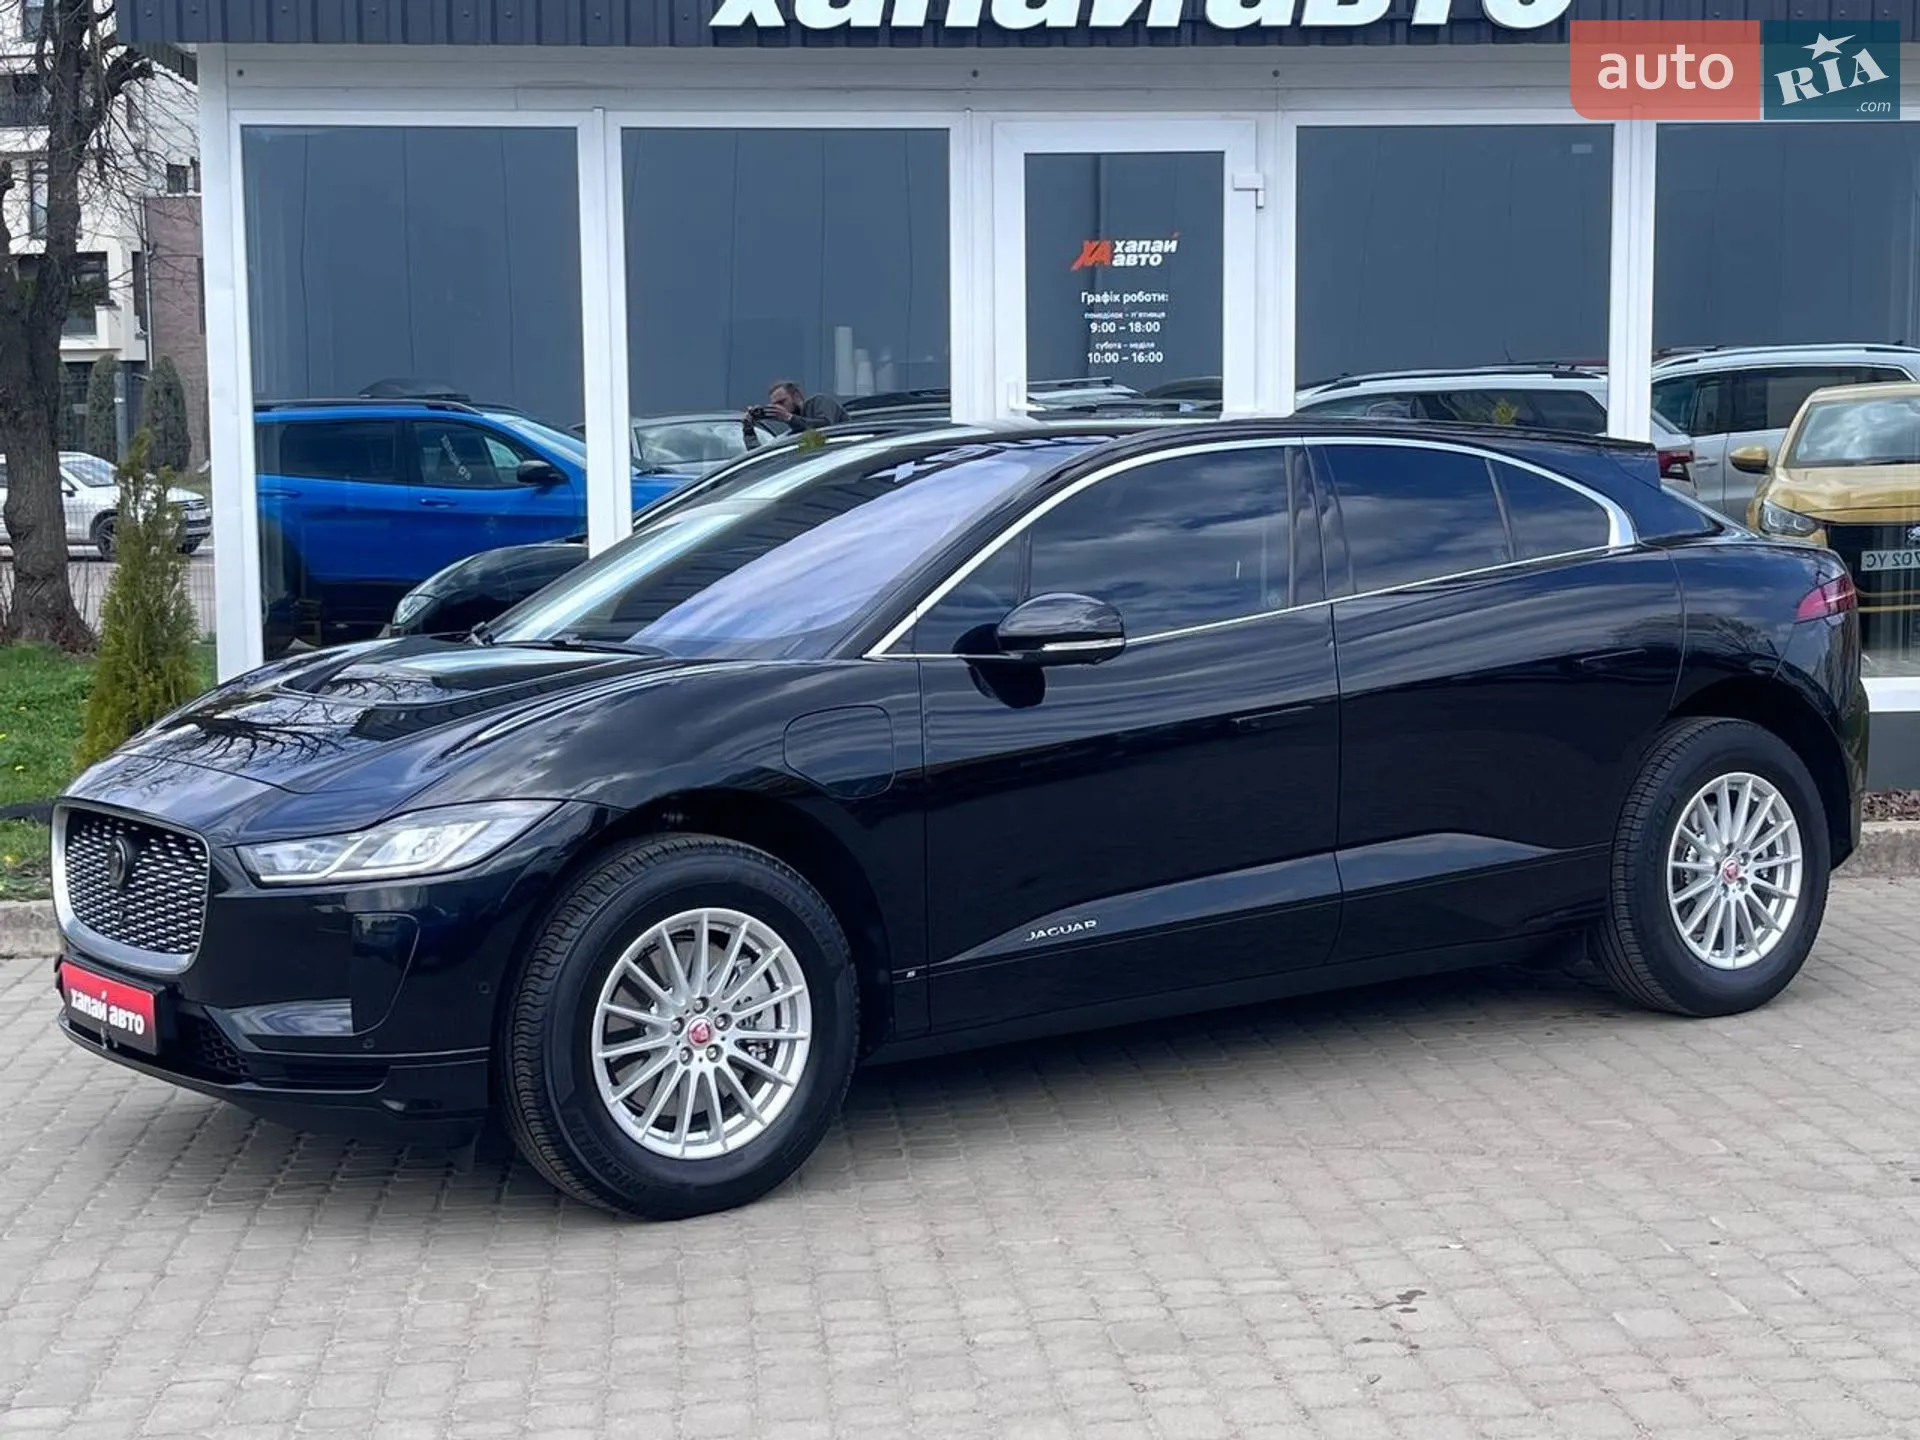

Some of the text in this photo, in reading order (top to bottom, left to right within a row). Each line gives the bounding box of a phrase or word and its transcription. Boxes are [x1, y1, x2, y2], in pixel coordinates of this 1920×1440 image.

[1112, 253, 1163, 267] авто
[1089, 322, 1116, 333] 9:00
[1128, 321, 1161, 333] 18:00
[1087, 352, 1119, 363] 10:00
[1131, 352, 1164, 363] 16:00
[1025, 920, 1097, 941] JAGUAR
[70, 987, 145, 1035] хапай авто
